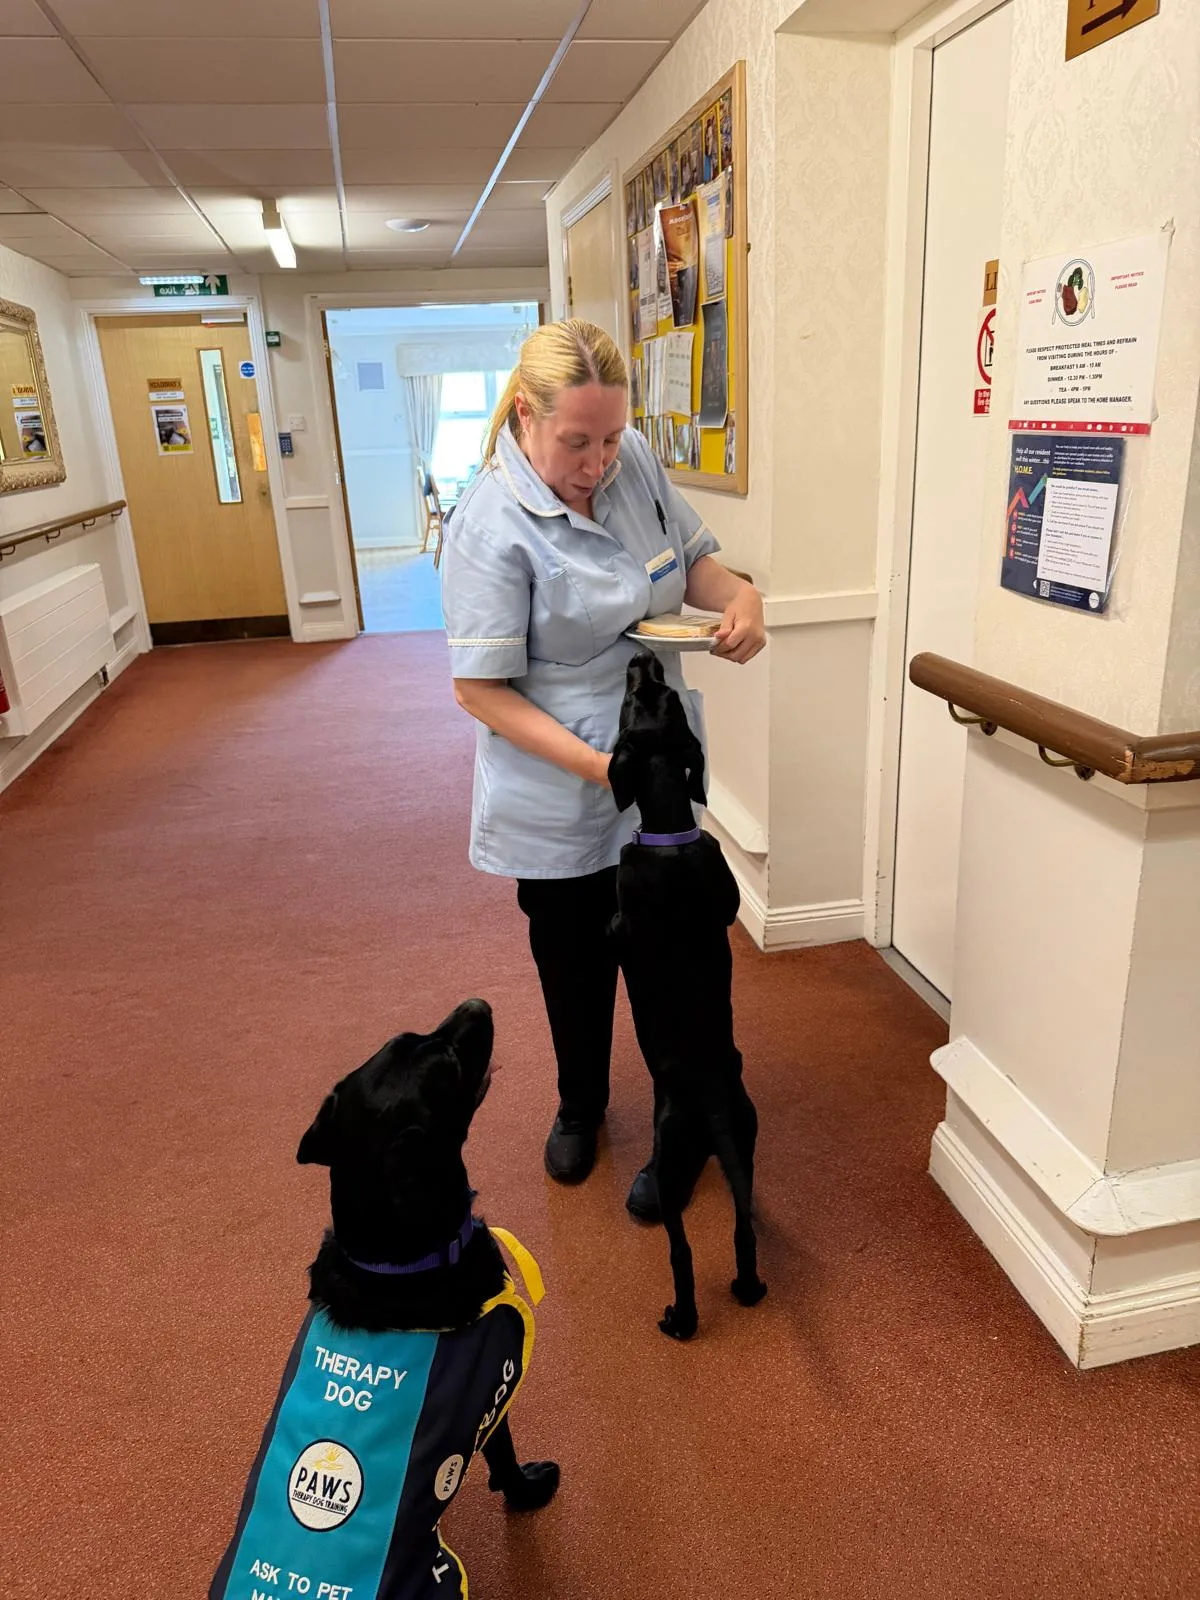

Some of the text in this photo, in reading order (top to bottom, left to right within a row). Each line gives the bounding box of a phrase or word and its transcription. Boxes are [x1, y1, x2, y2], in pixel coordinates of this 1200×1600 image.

[1055, 343, 1080, 351] PROTECTED
[315, 1346, 408, 1390] THERAPY
[324, 1380, 373, 1411] DOG
[295, 1466, 352, 1503] PAWS
[443, 1461, 458, 1492] PAWS
[293, 1490, 348, 1513] THERAPY DOG TRAINING
[249, 1559, 282, 1585] ASK
[288, 1572, 311, 1594] TO
[316, 1582, 353, 1600] PET
